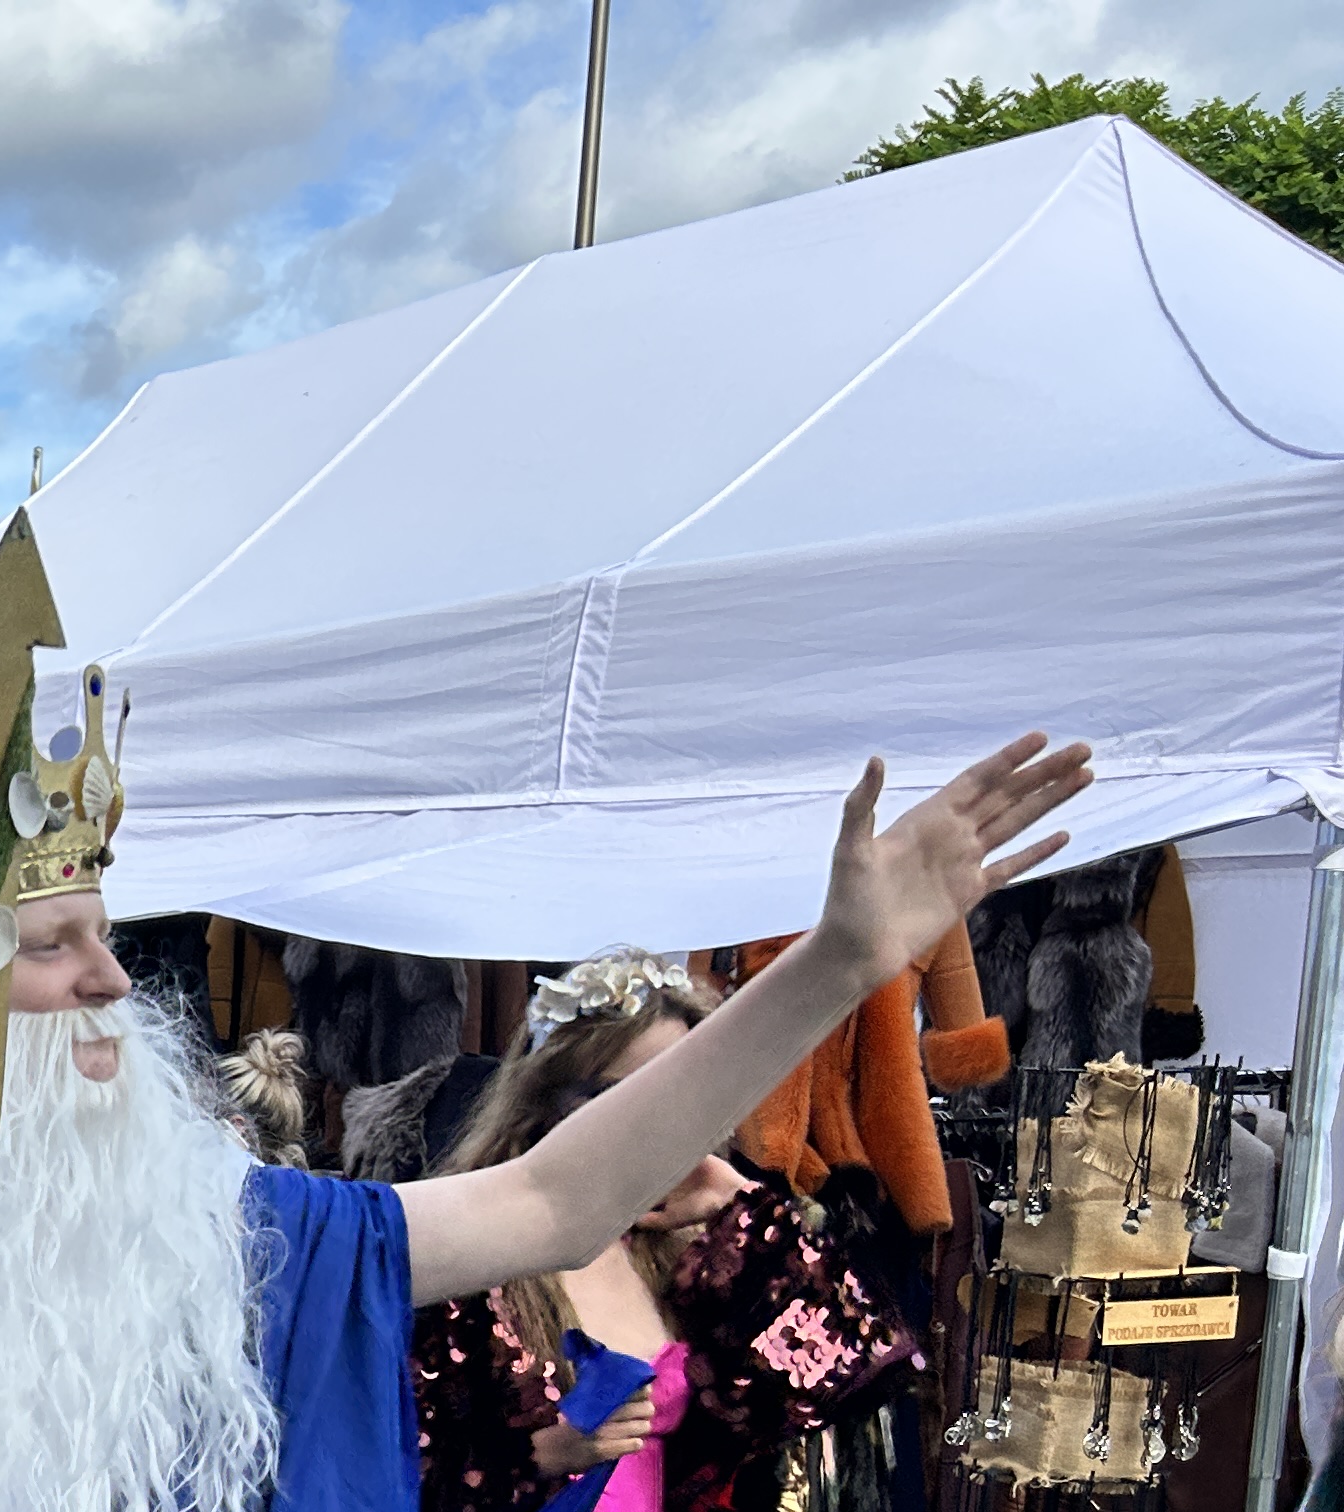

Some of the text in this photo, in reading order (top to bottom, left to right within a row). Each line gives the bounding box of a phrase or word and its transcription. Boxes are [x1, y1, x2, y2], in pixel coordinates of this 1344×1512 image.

[1152, 1303, 1198, 1318] TOWAR
[1107, 1322, 1231, 1341] PODAJE SPRZEDAWCA
